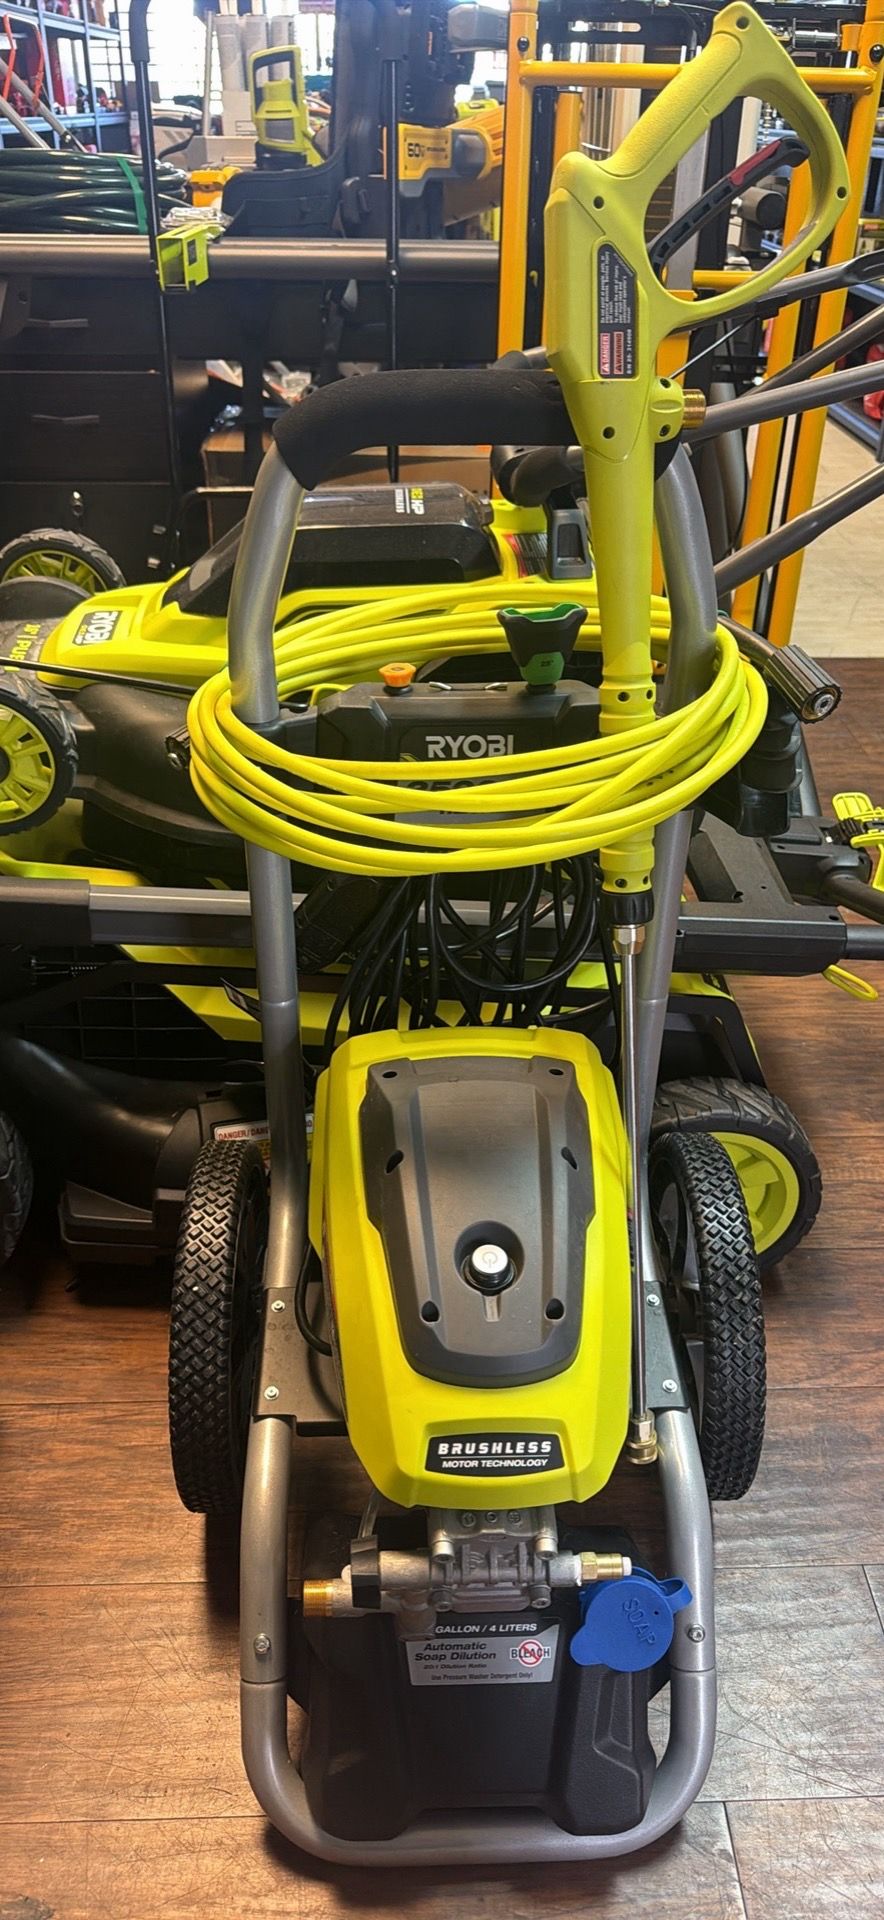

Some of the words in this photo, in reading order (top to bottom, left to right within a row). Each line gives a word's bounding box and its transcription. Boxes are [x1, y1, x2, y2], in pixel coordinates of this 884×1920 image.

[82, 611, 119, 644] RYOBI
[425, 734, 514, 758] RYOBI
[438, 1441, 552, 1455] BRUSHLESS
[442, 1460, 479, 1468] MOTOR
[480, 1458, 549, 1468] TECHNOLOGY
[622, 1598, 656, 1645] SOAP
[435, 1624, 480, 1633] GALLON
[489, 1624, 496, 1632] 4
[500, 1623, 537, 1632] LITERS
[424, 1642, 487, 1651] Automatic
[415, 1652, 447, 1662] Soap
[450, 1651, 497, 1660] Dilution
[511, 1647, 550, 1659] BLEACH
[490, 1672, 517, 1680] Detergent
